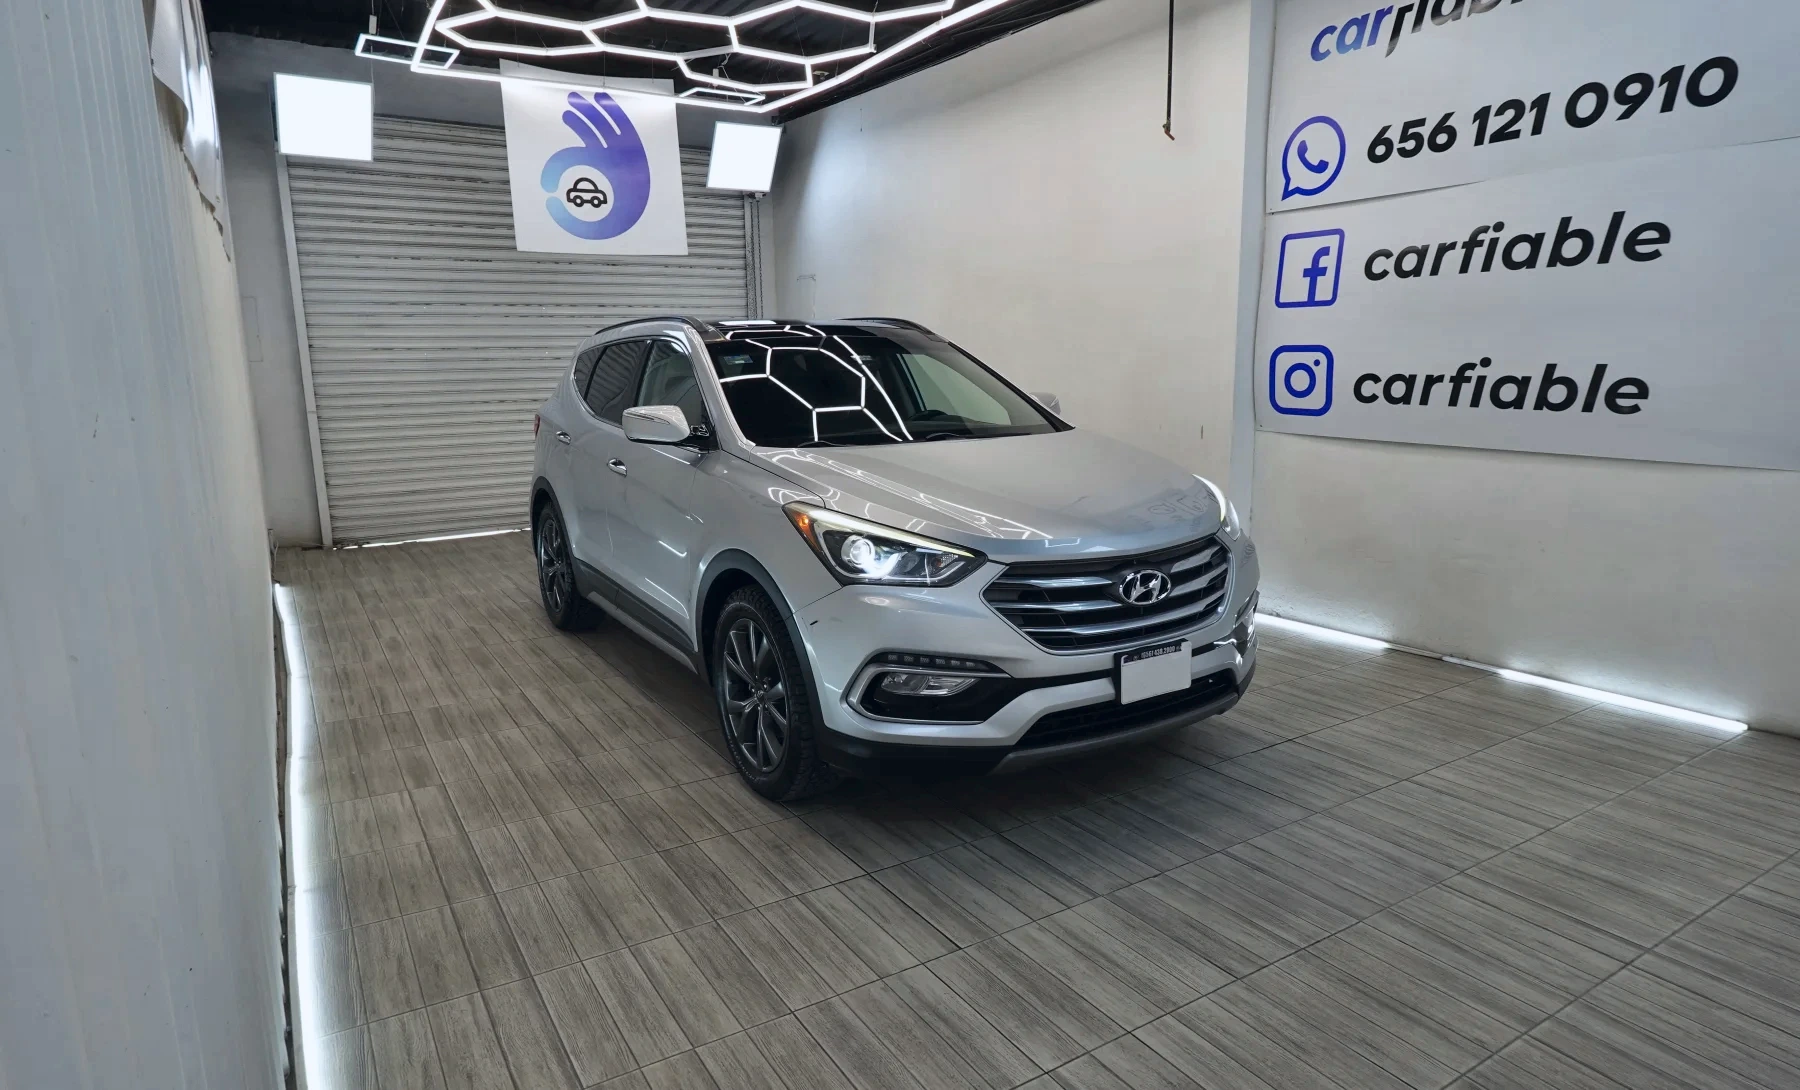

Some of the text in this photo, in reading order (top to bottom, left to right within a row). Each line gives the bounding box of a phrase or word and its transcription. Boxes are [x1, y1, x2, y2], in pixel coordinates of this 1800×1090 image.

[1310, 0, 1523, 62] carfia
[1367, 56, 1739, 164] 656 121 0910
[1364, 210, 1672, 282] carfiable
[1353, 356, 1650, 415] carfiable
